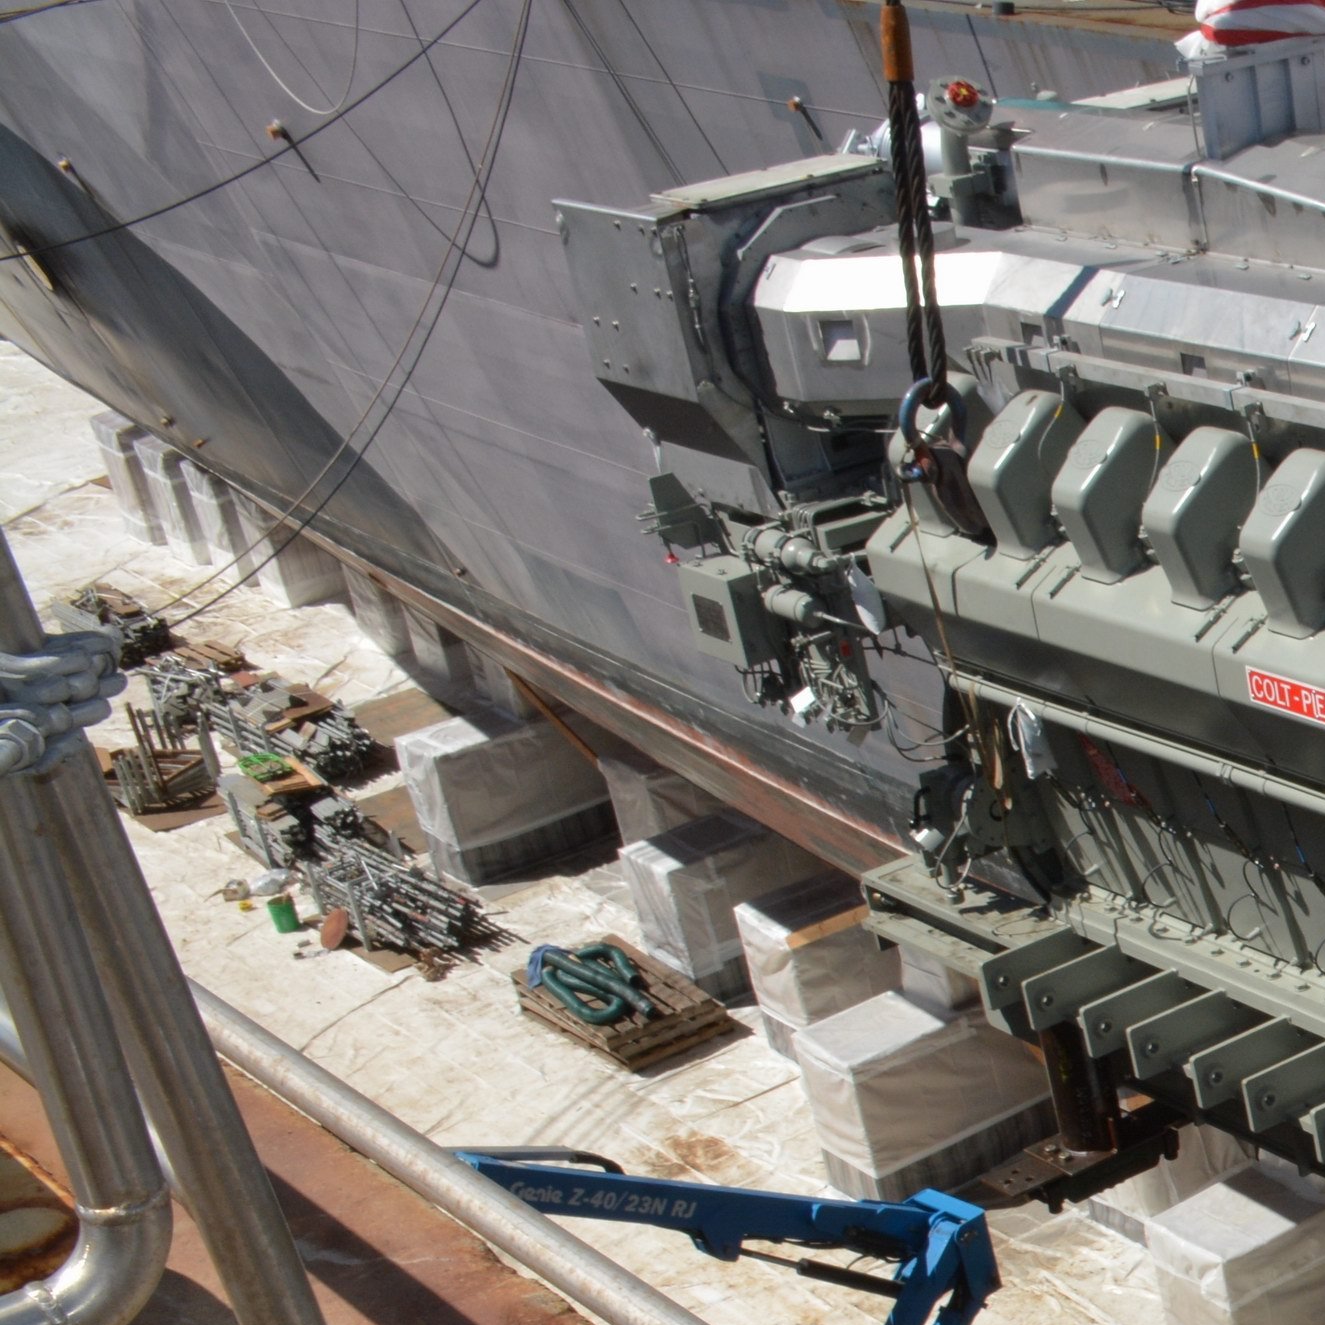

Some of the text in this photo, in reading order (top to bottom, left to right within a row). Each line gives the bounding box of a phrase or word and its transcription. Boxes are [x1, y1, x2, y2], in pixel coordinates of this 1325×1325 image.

[509, 1181, 698, 1219] Genie Z-40/23N RJ
